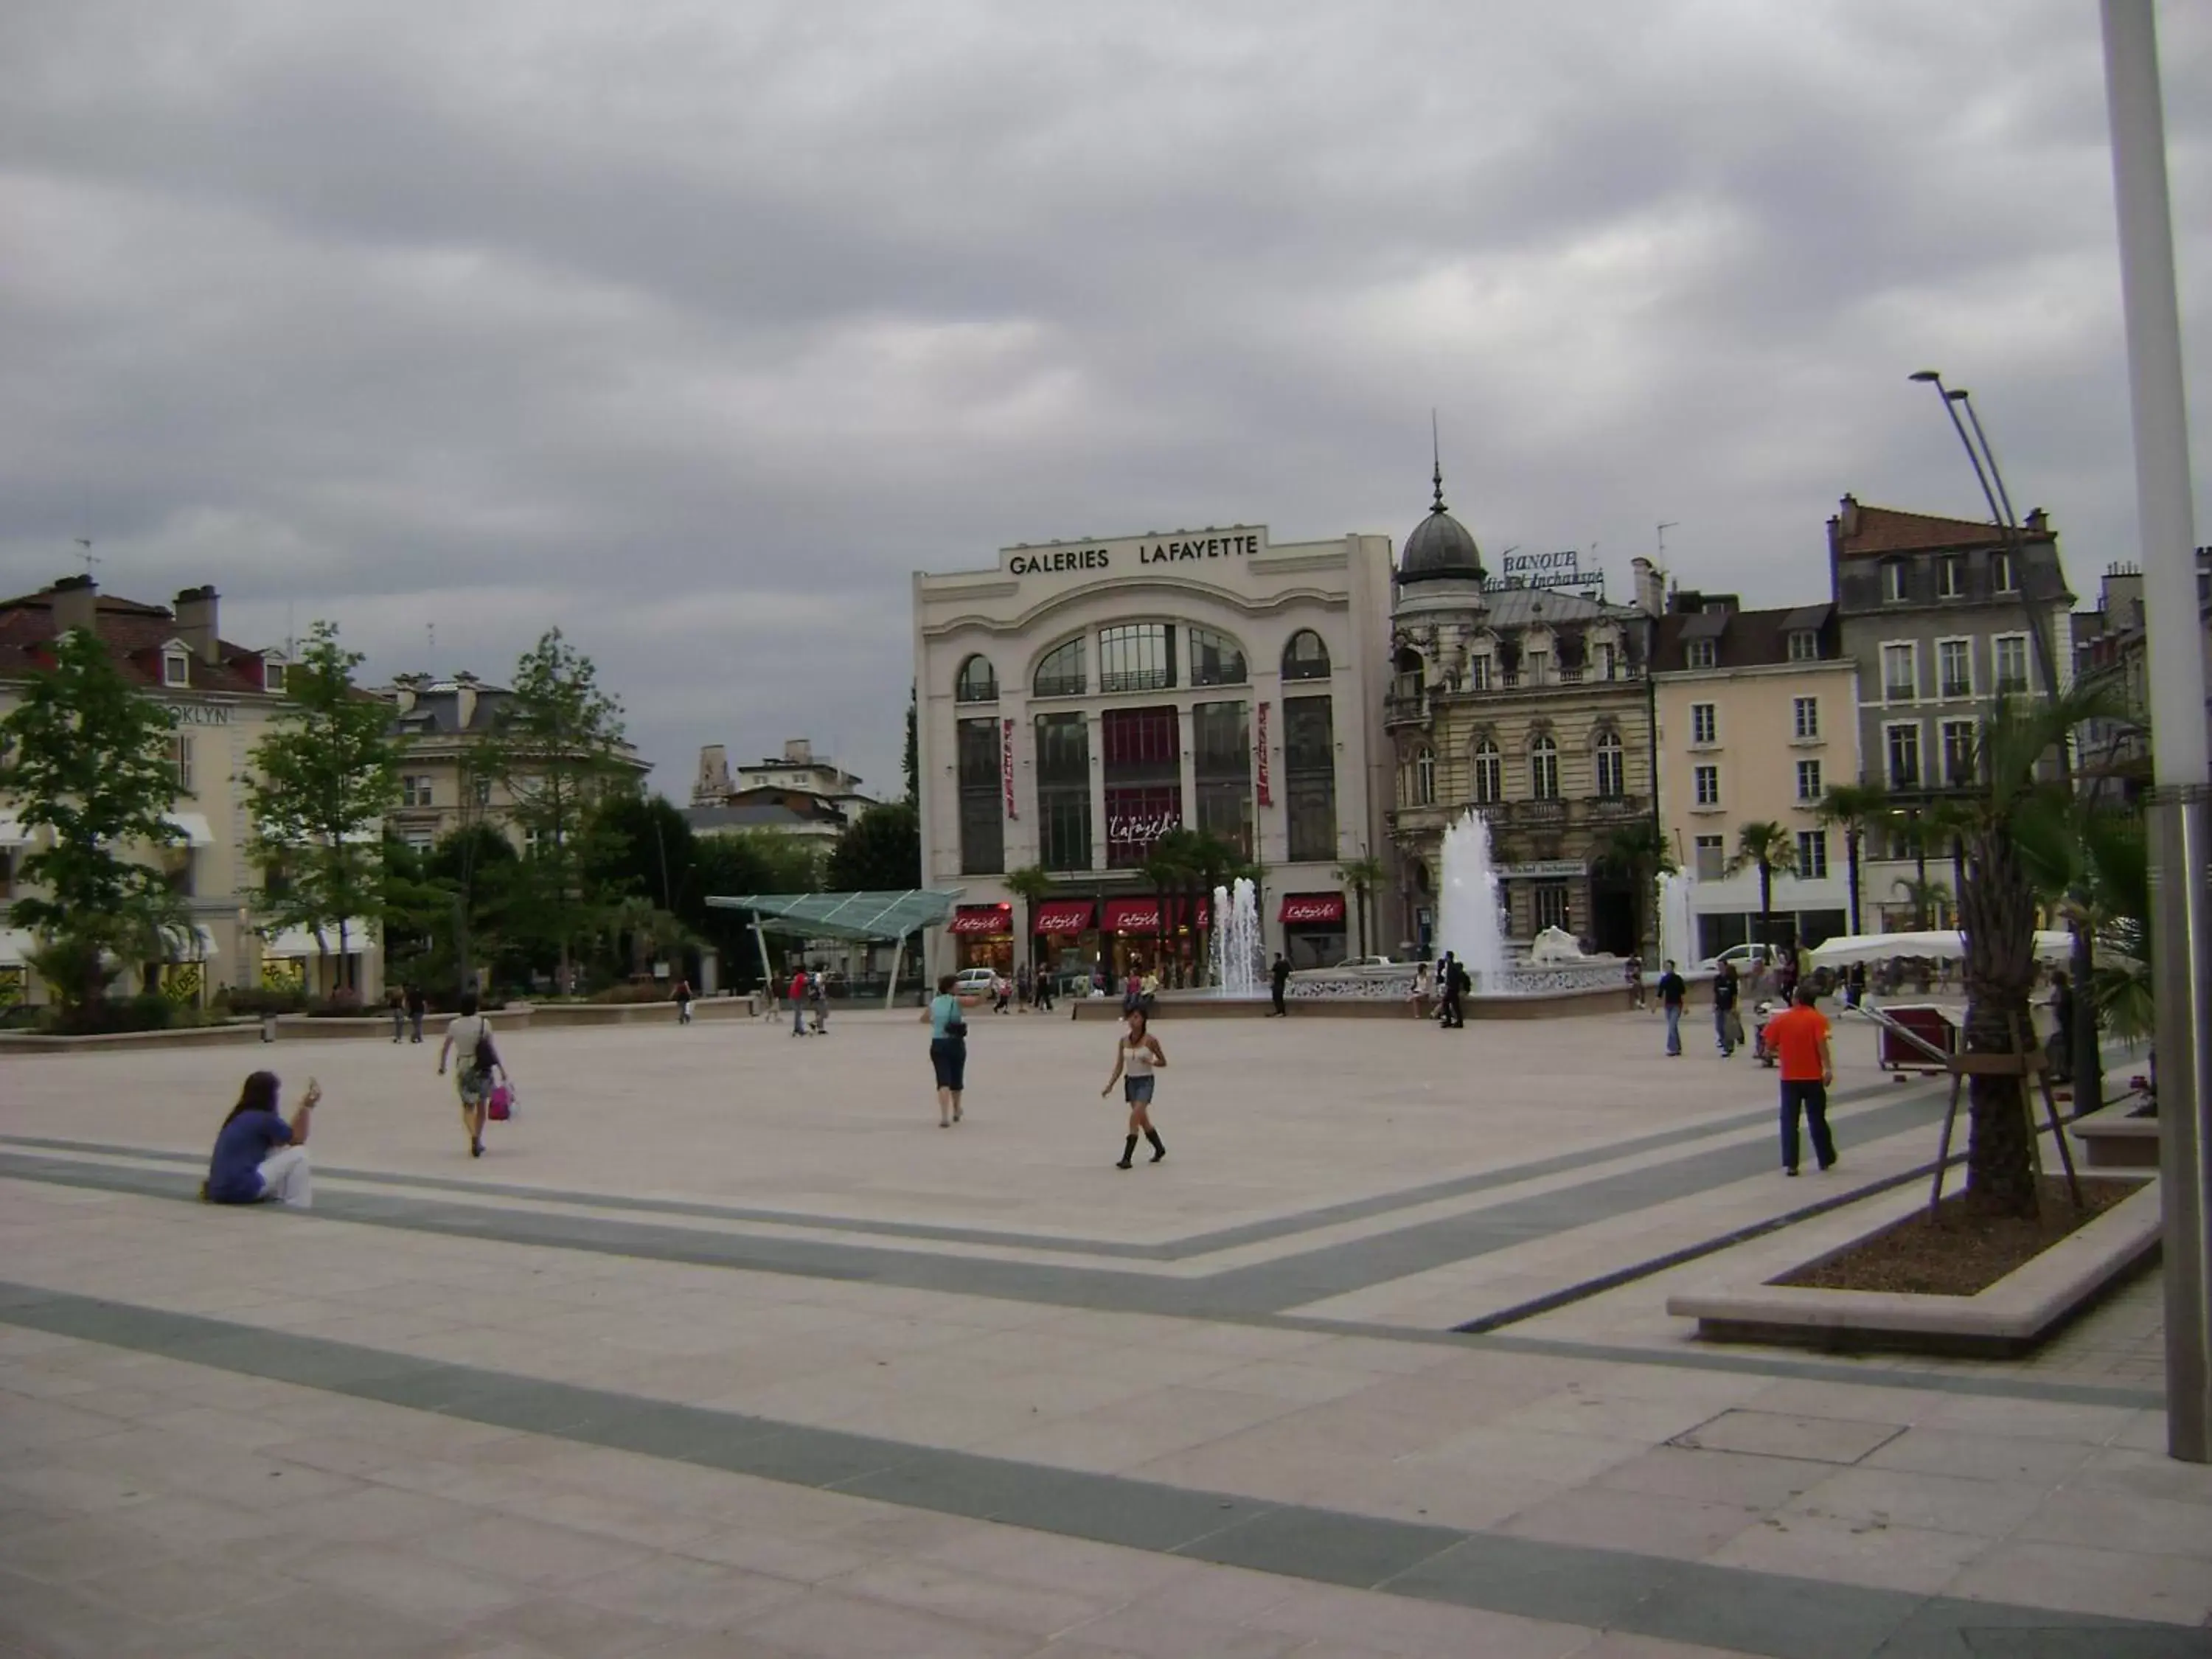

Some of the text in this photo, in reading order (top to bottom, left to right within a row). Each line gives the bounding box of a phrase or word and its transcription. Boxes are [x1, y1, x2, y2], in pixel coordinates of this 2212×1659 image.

[1009, 535, 1258, 575] GALERIES LAFAYETTE
[167, 706, 228, 726] OKLYN
